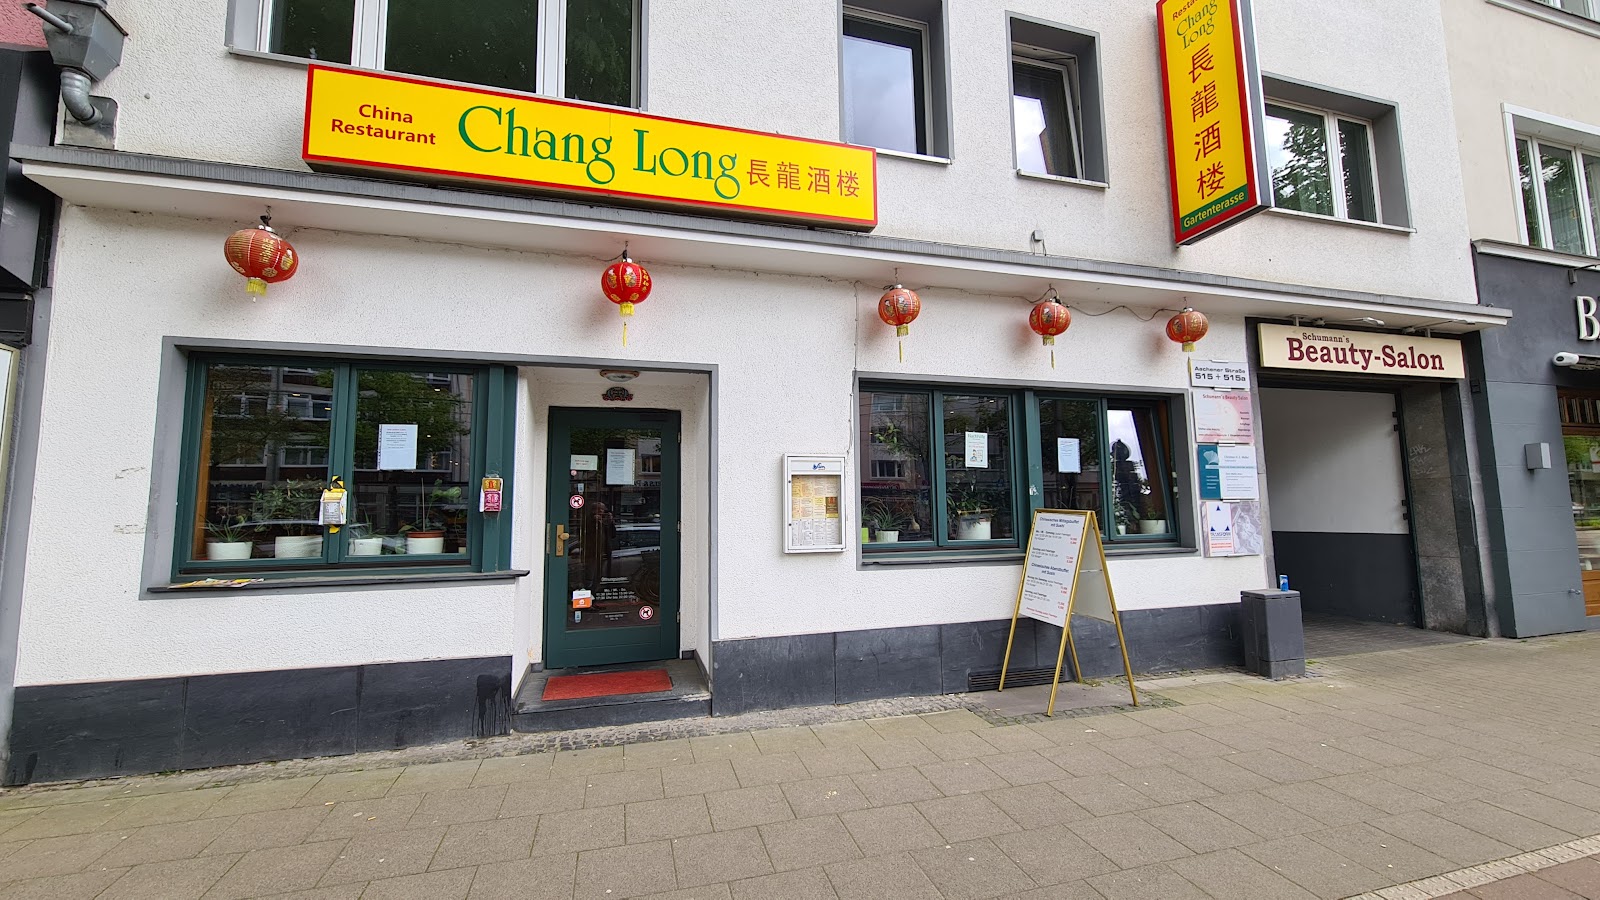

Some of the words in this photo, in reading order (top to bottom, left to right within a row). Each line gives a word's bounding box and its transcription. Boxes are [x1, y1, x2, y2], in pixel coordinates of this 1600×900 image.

[1172, 0, 1198, 21] Resta
[1177, 0, 1217, 36] Chang
[1183, 16, 1215, 50] Long
[358, 104, 413, 124] China
[331, 119, 436, 145] Restaurant
[458, 105, 615, 185] Chang
[633, 129, 740, 199] Long
[1183, 191, 1244, 228] Gartenterasse
[1286, 338, 1444, 371] Beauty-Salon
[1195, 372, 1214, 381] 515
[1223, 374, 1246, 383] 515a
